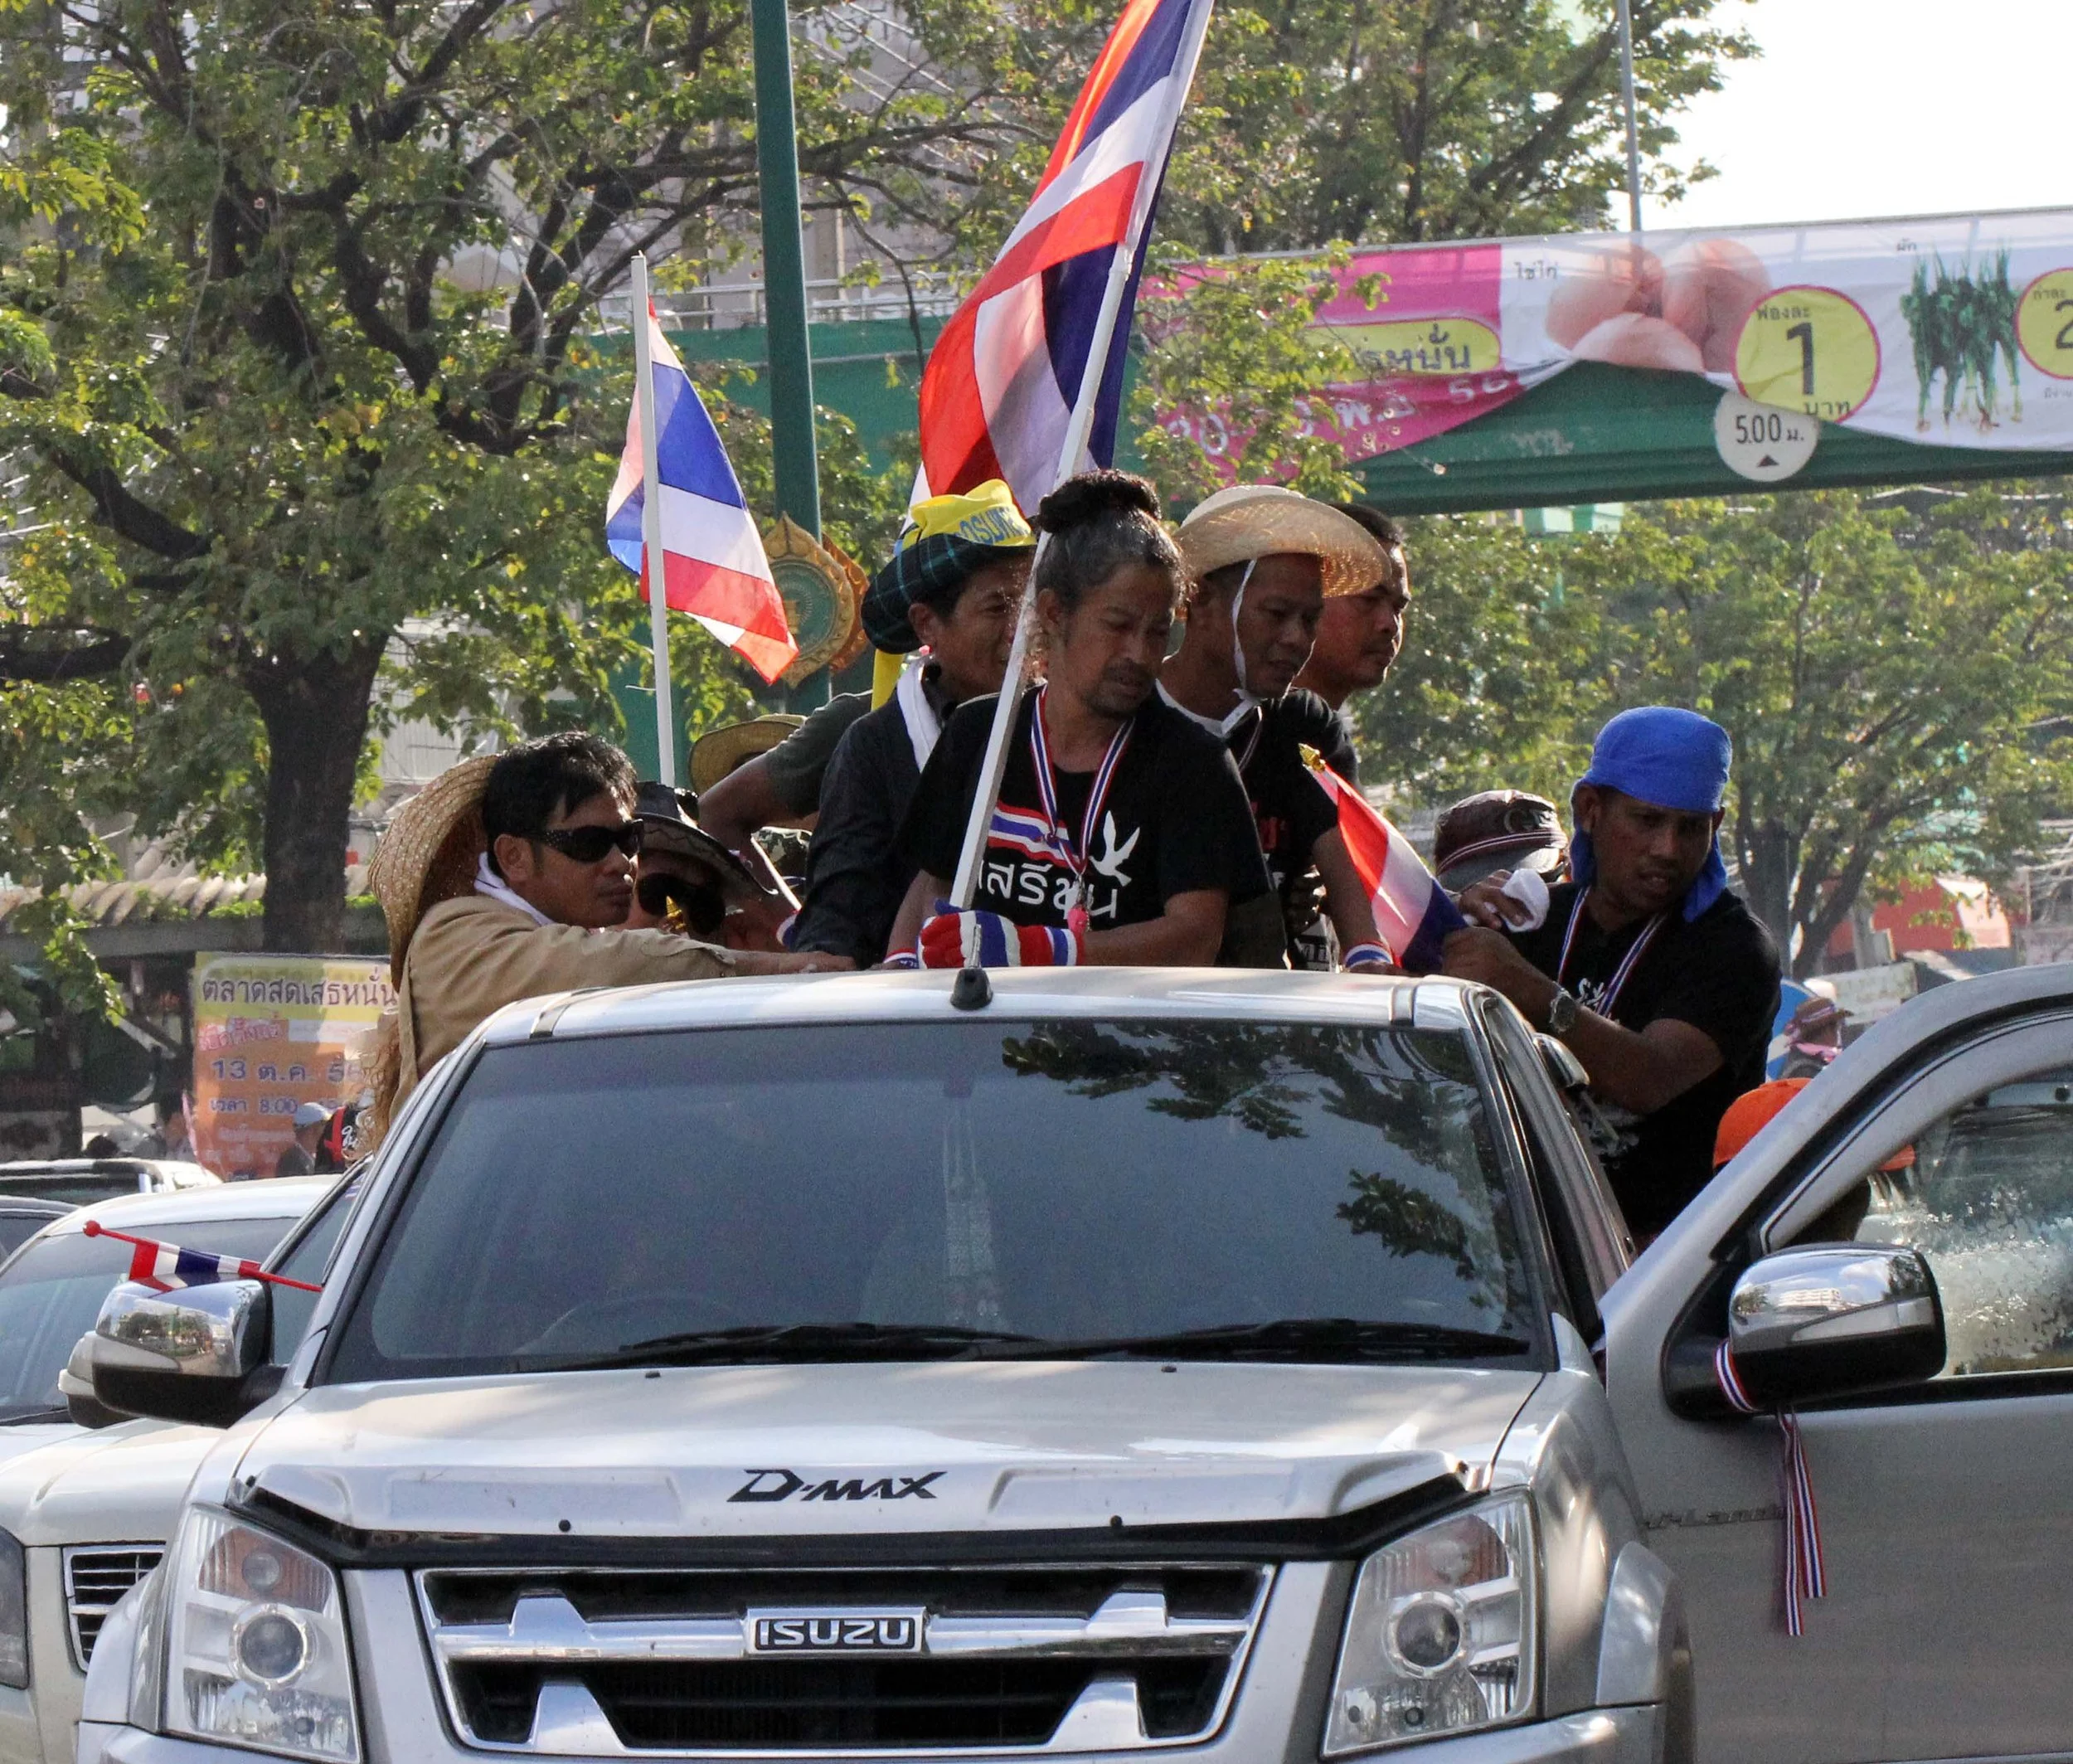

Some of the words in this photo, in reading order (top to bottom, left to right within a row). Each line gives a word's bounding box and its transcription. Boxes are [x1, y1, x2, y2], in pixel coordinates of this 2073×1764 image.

[1787, 322, 1814, 396] 1
[1805, 401, 1851, 415] บาท
[212, 1060, 246, 1080] 13
[760, 1620, 910, 1645] ISUZU
